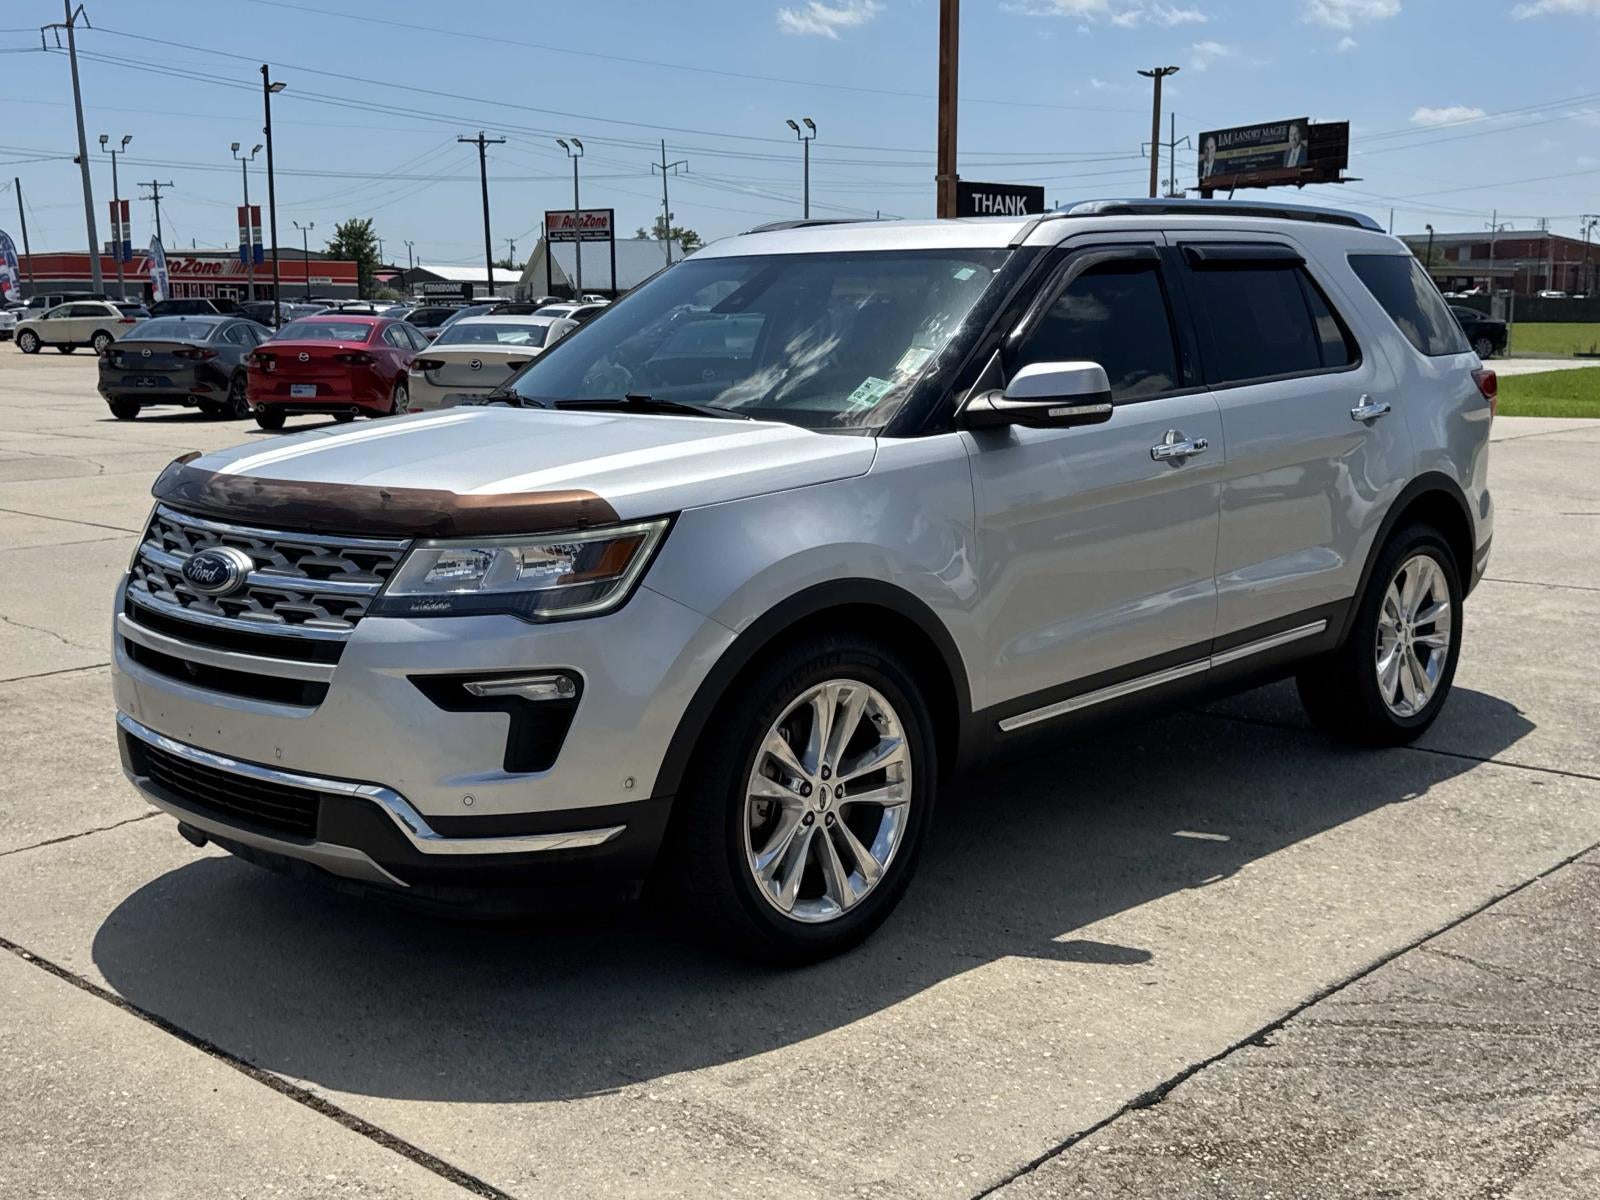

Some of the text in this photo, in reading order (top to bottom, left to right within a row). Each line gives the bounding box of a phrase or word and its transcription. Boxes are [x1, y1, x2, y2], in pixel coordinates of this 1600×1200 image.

[971, 192, 1027, 217] THANK
[561, 214, 608, 228] AuoZone
[140, 256, 223, 274] AoZone
[188, 557, 220, 583] Ford
